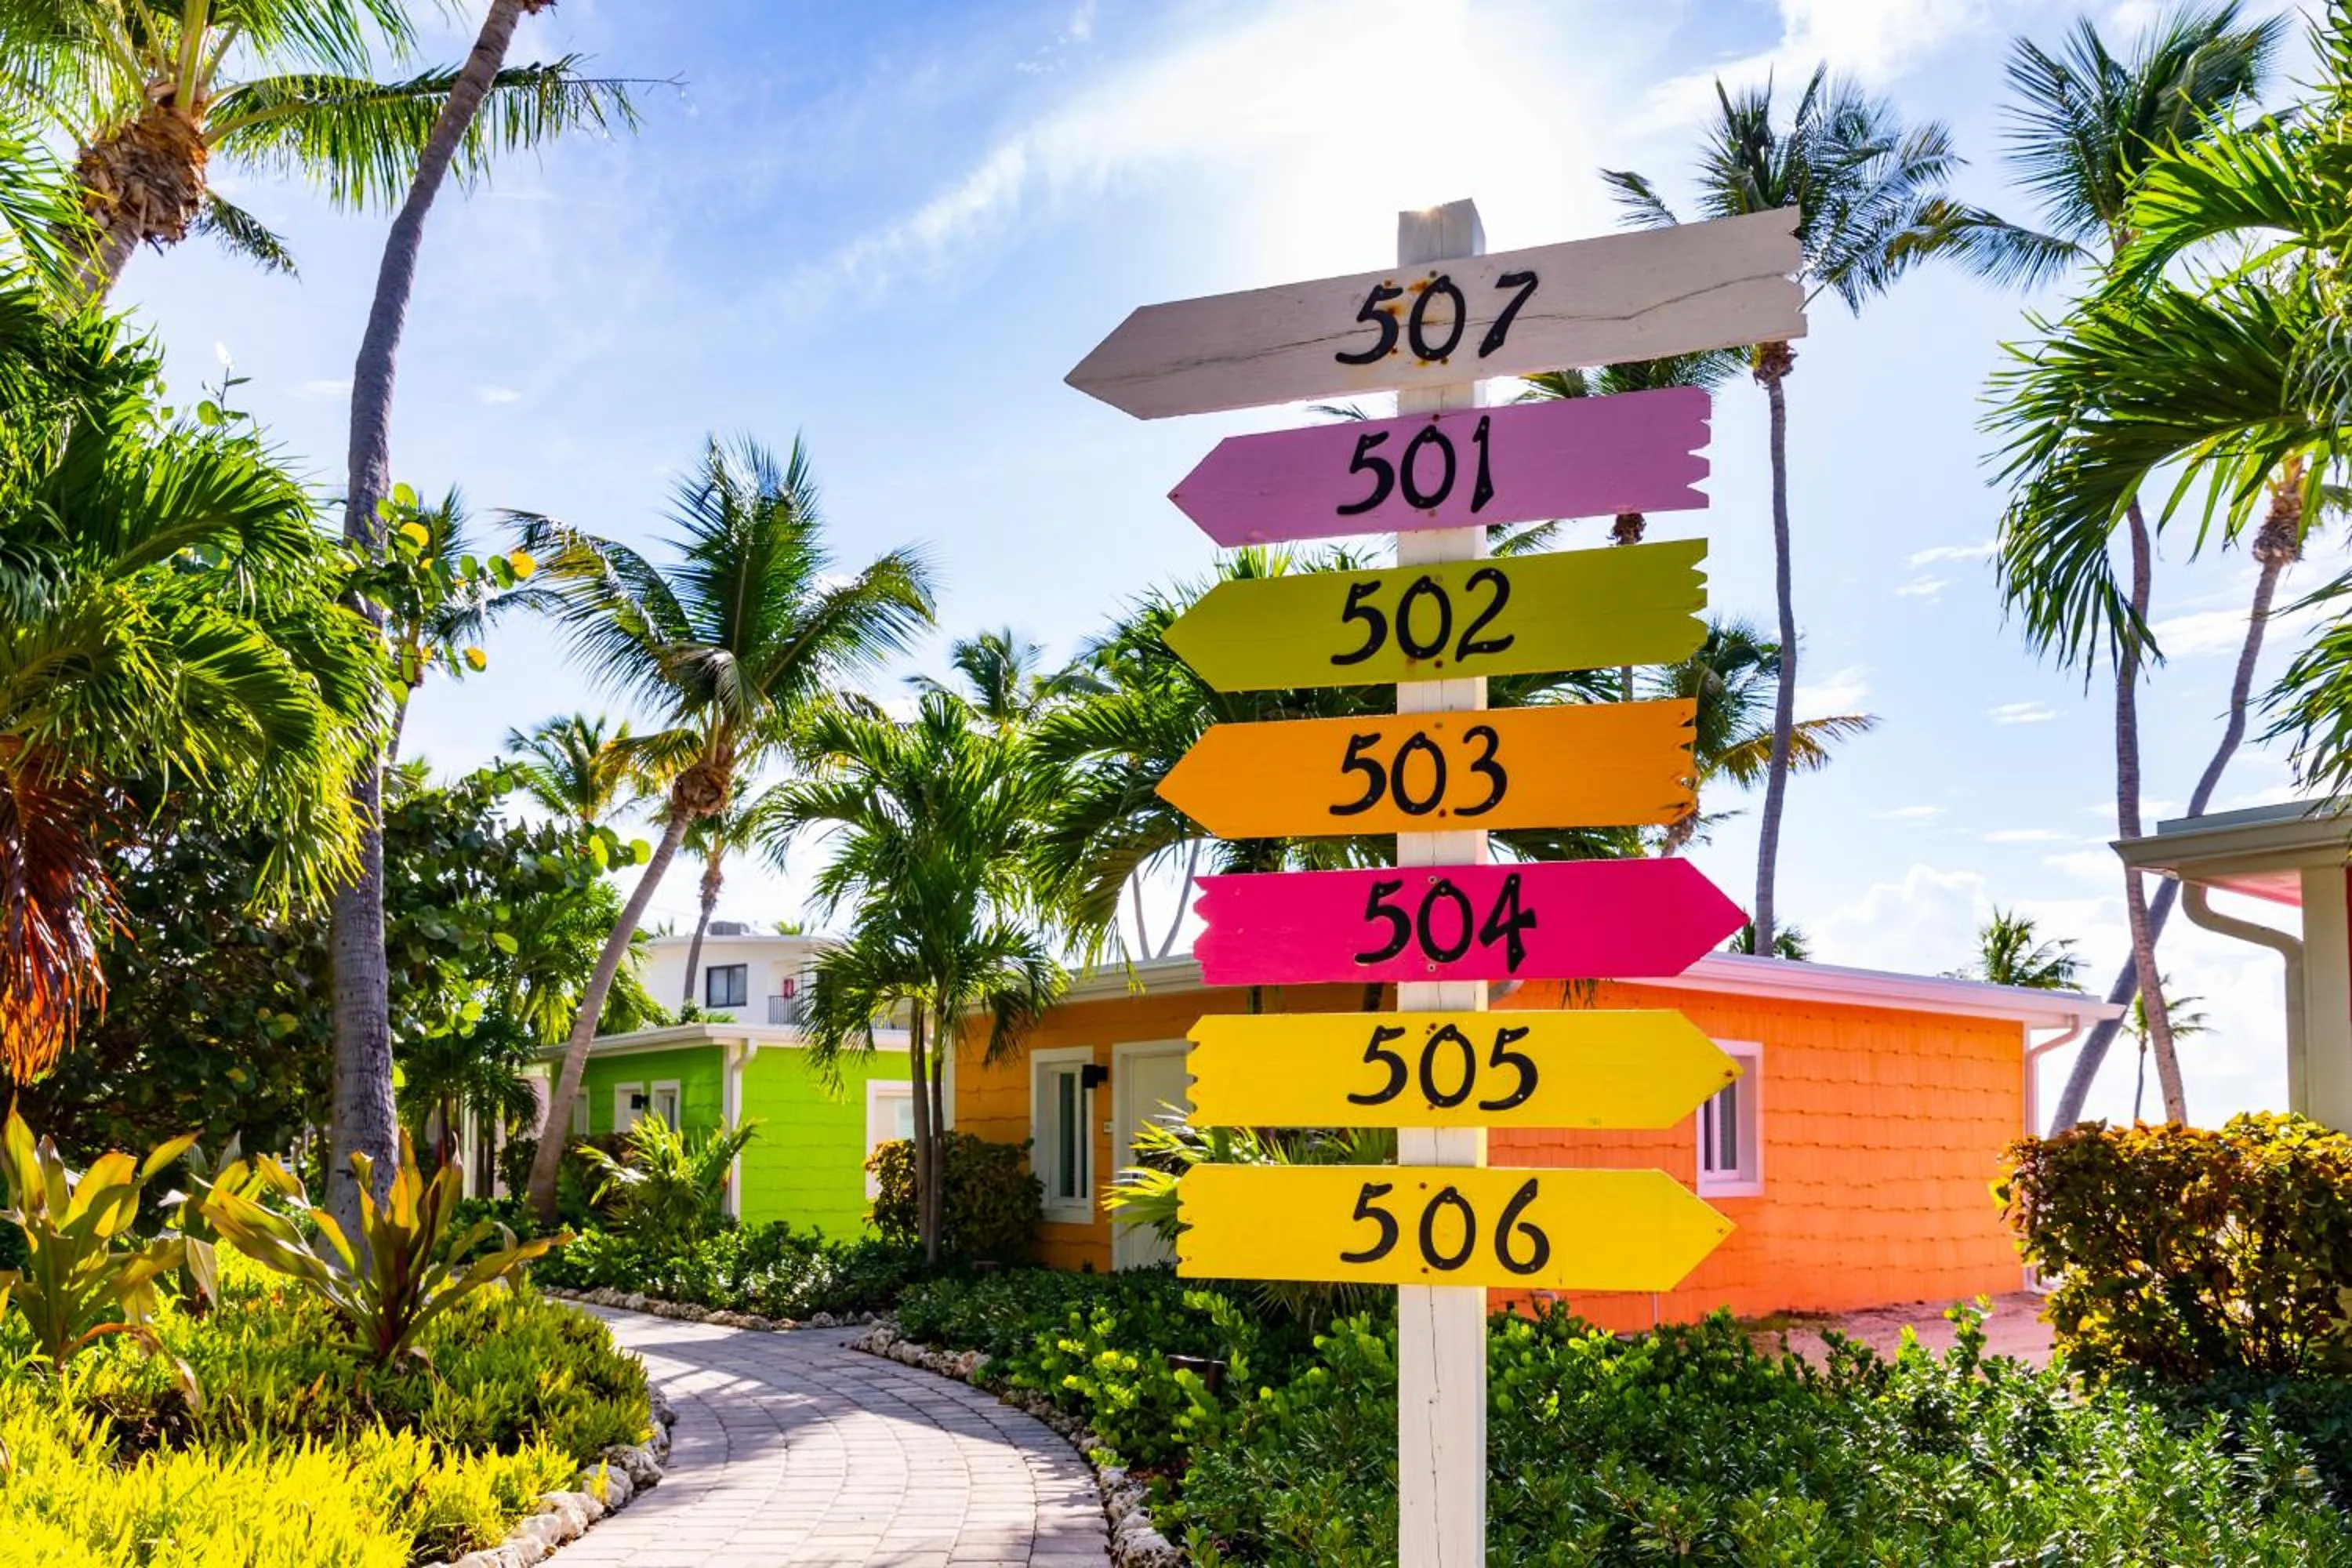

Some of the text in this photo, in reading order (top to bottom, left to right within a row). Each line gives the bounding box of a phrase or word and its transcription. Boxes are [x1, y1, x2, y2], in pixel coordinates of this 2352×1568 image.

[1334, 270, 1539, 365] 507
[1336, 415, 1495, 516] 501
[1330, 567, 1515, 666] 502
[1328, 724, 1508, 816] 503
[1354, 873, 1537, 973] 504
[1347, 1024, 1538, 1111] 505
[1340, 1178, 1550, 1275] 506
